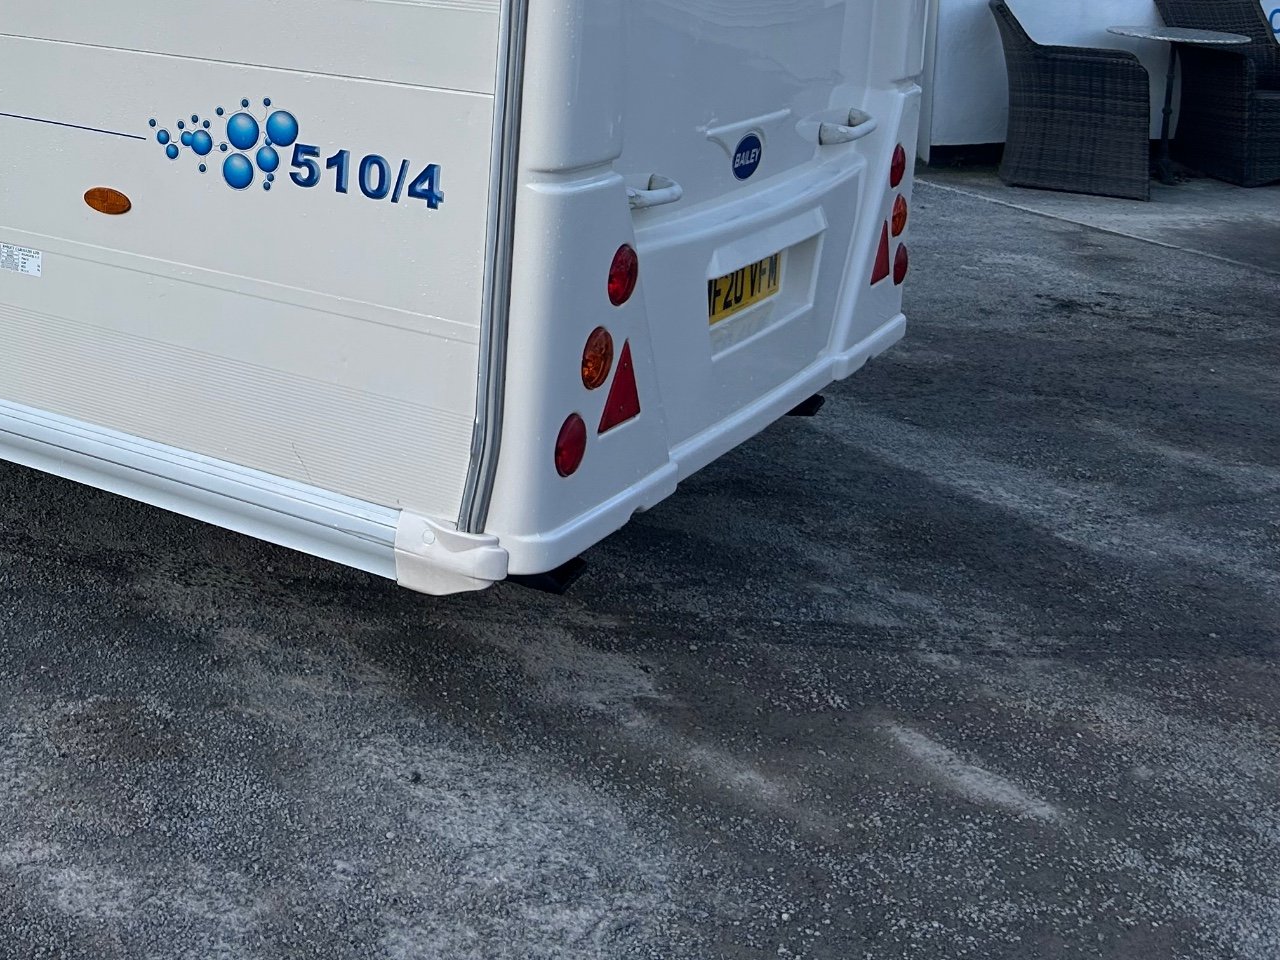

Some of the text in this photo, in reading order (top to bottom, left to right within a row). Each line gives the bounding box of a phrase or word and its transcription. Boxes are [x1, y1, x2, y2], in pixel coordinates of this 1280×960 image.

[288, 143, 445, 210] 510/4
[734, 147, 760, 168] BAILEY
[708, 268, 745, 318] F20
